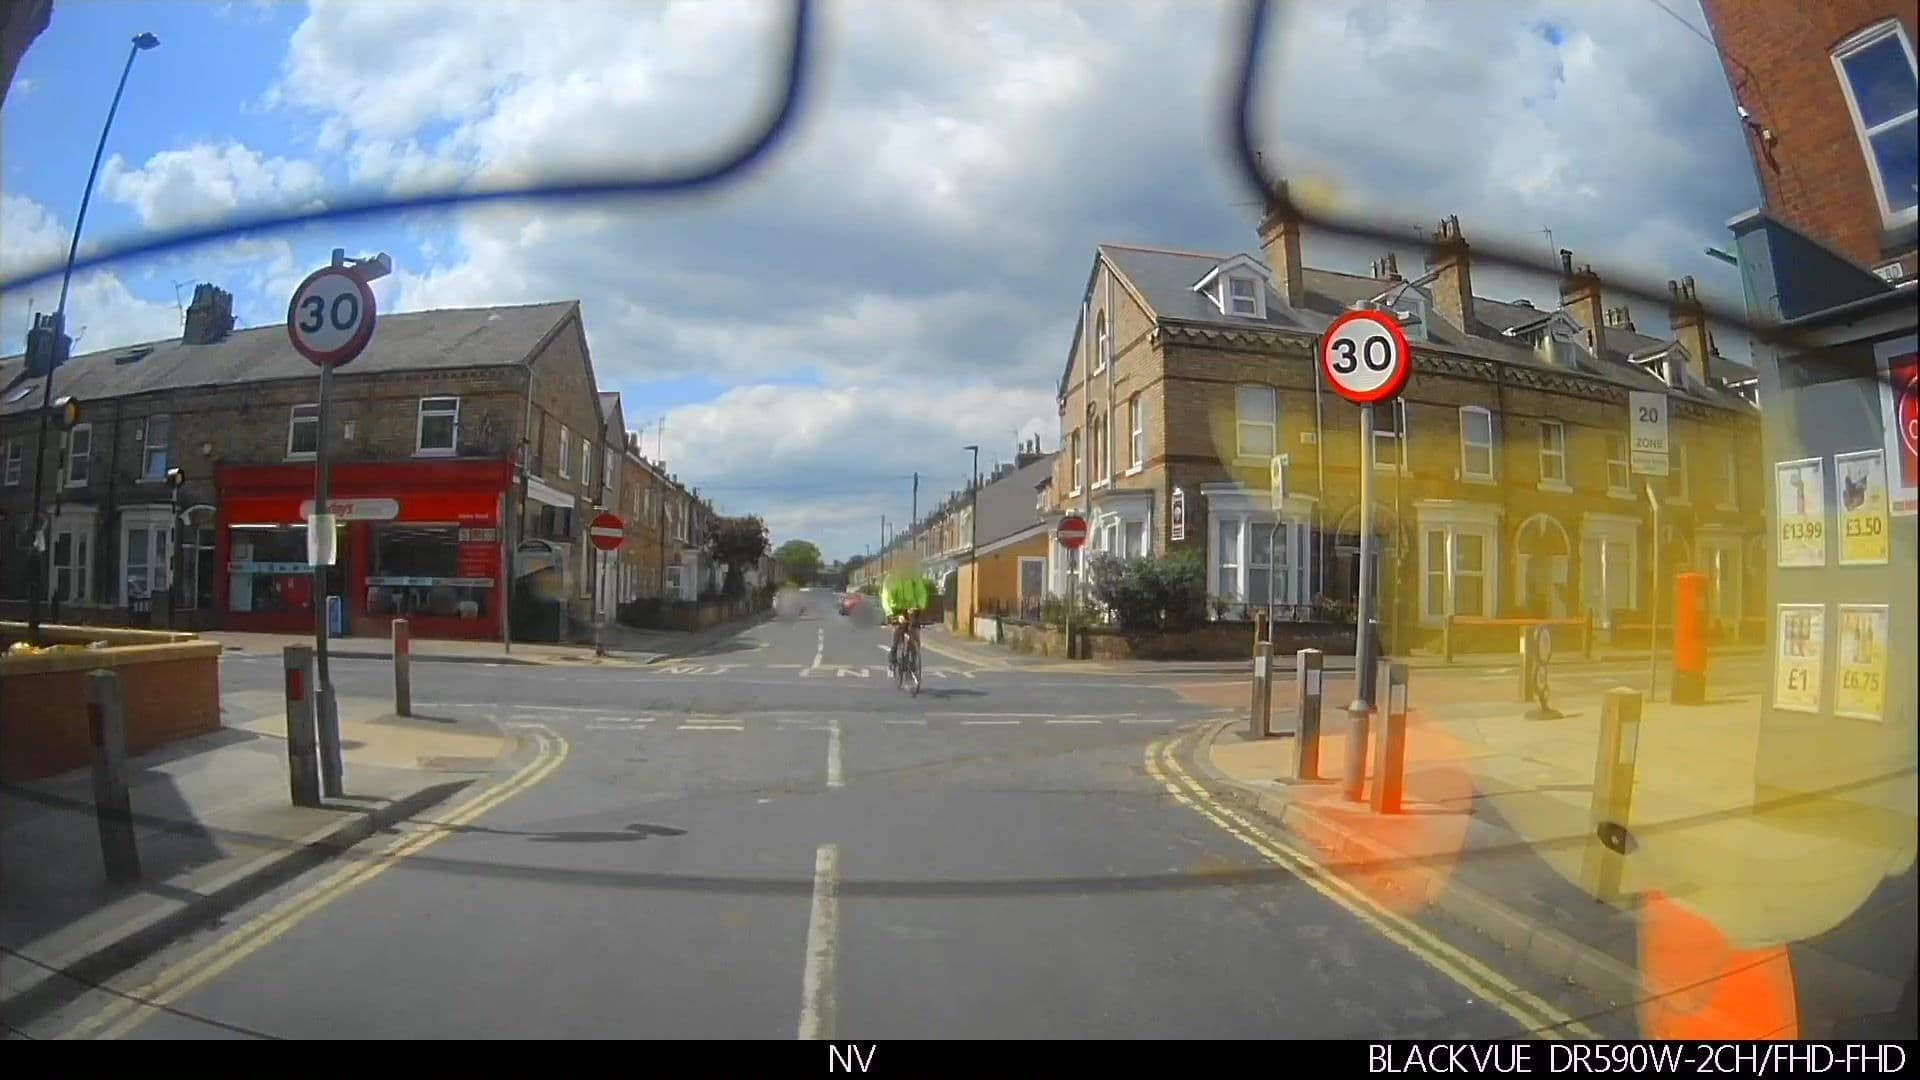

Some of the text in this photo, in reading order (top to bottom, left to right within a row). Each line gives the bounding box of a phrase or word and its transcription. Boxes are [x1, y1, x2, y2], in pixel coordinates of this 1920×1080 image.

[299, 292, 359, 334] 30
[1331, 335, 1392, 374] 30
[1639, 406, 1658, 424] 20
[1635, 438, 1665, 449] ZONE
[1783, 521, 1823, 540] £13.99
[1846, 517, 1882, 537] £3.50
[1788, 667, 1808, 692] £1
[1842, 669, 1880, 692] £6.75
